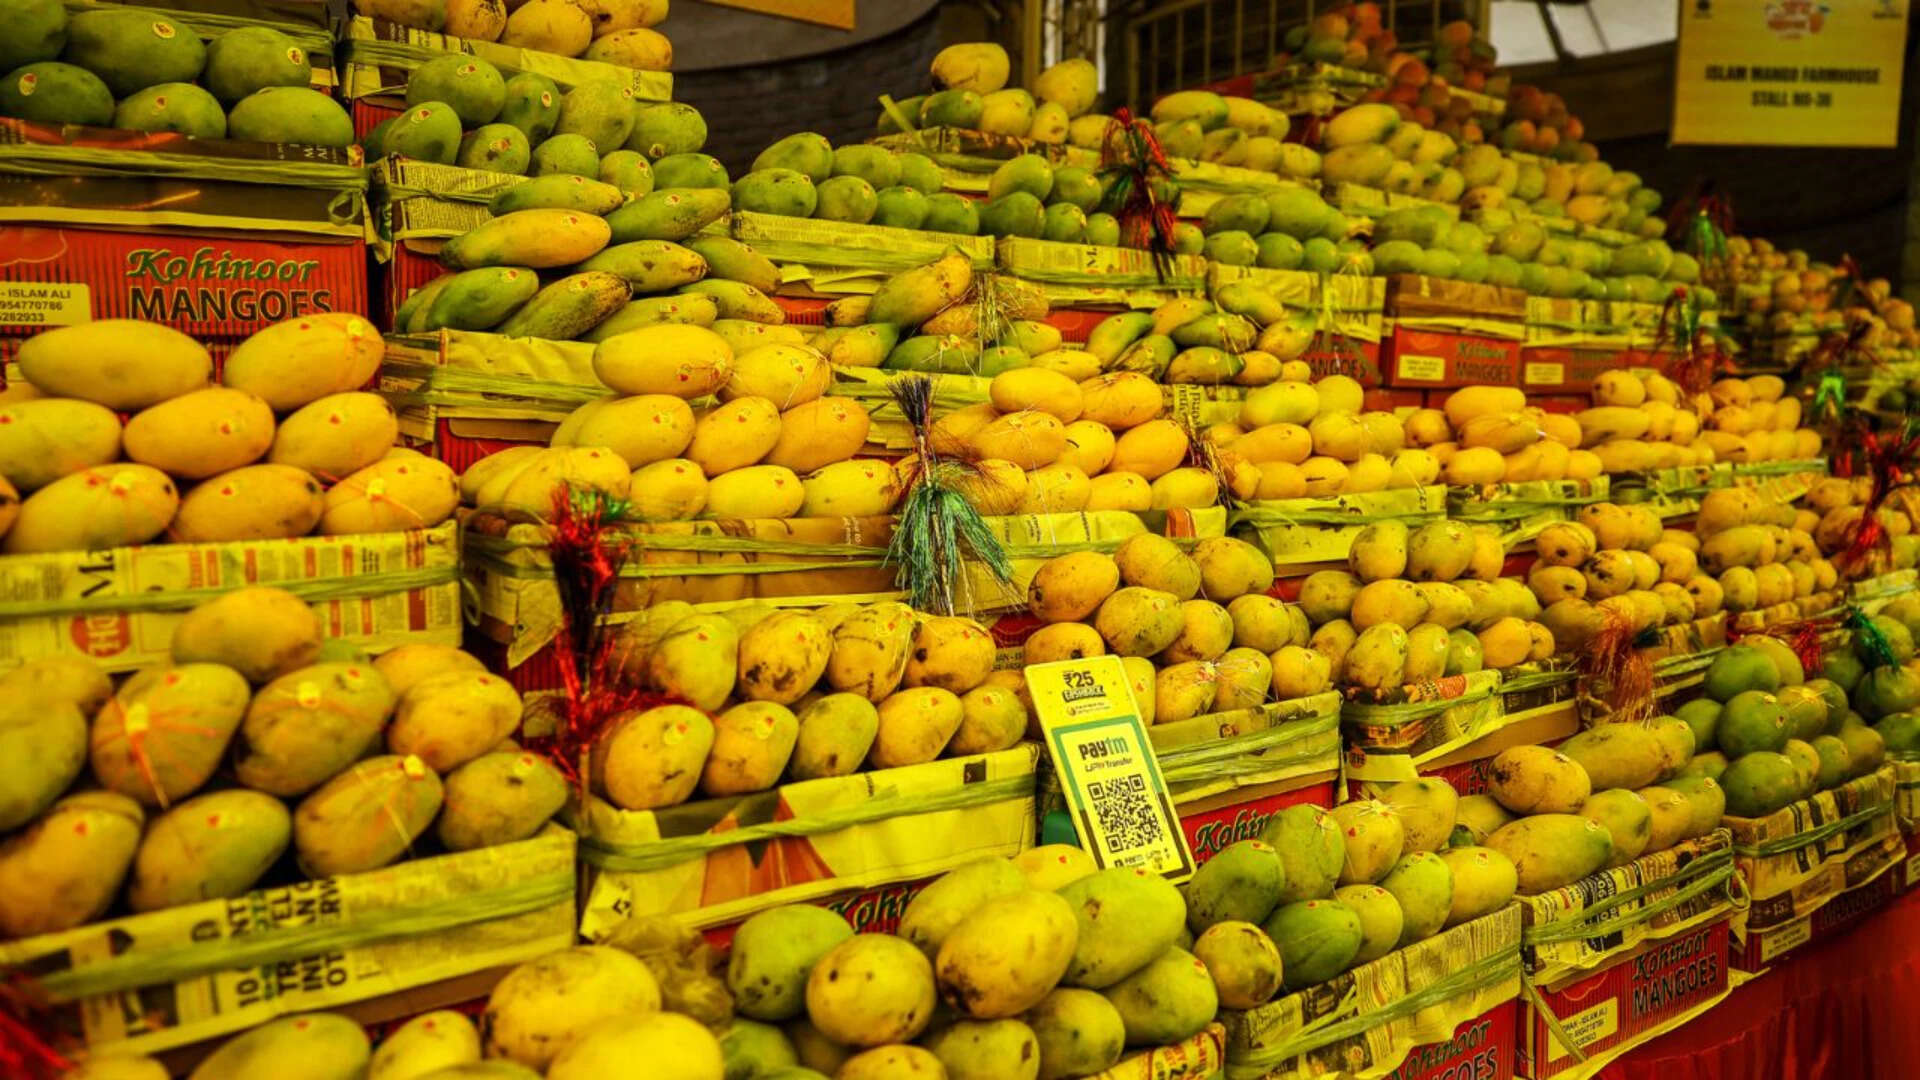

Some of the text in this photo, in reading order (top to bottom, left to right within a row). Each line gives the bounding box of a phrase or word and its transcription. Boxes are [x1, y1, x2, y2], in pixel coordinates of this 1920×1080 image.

[126, 247, 319, 284] Kohinoor
[8, 288, 48, 299] ISLAM
[50, 289, 72, 300] ALI
[130, 285, 333, 323] MANGOES
[1631, 951, 1718, 1019] MANGOES
